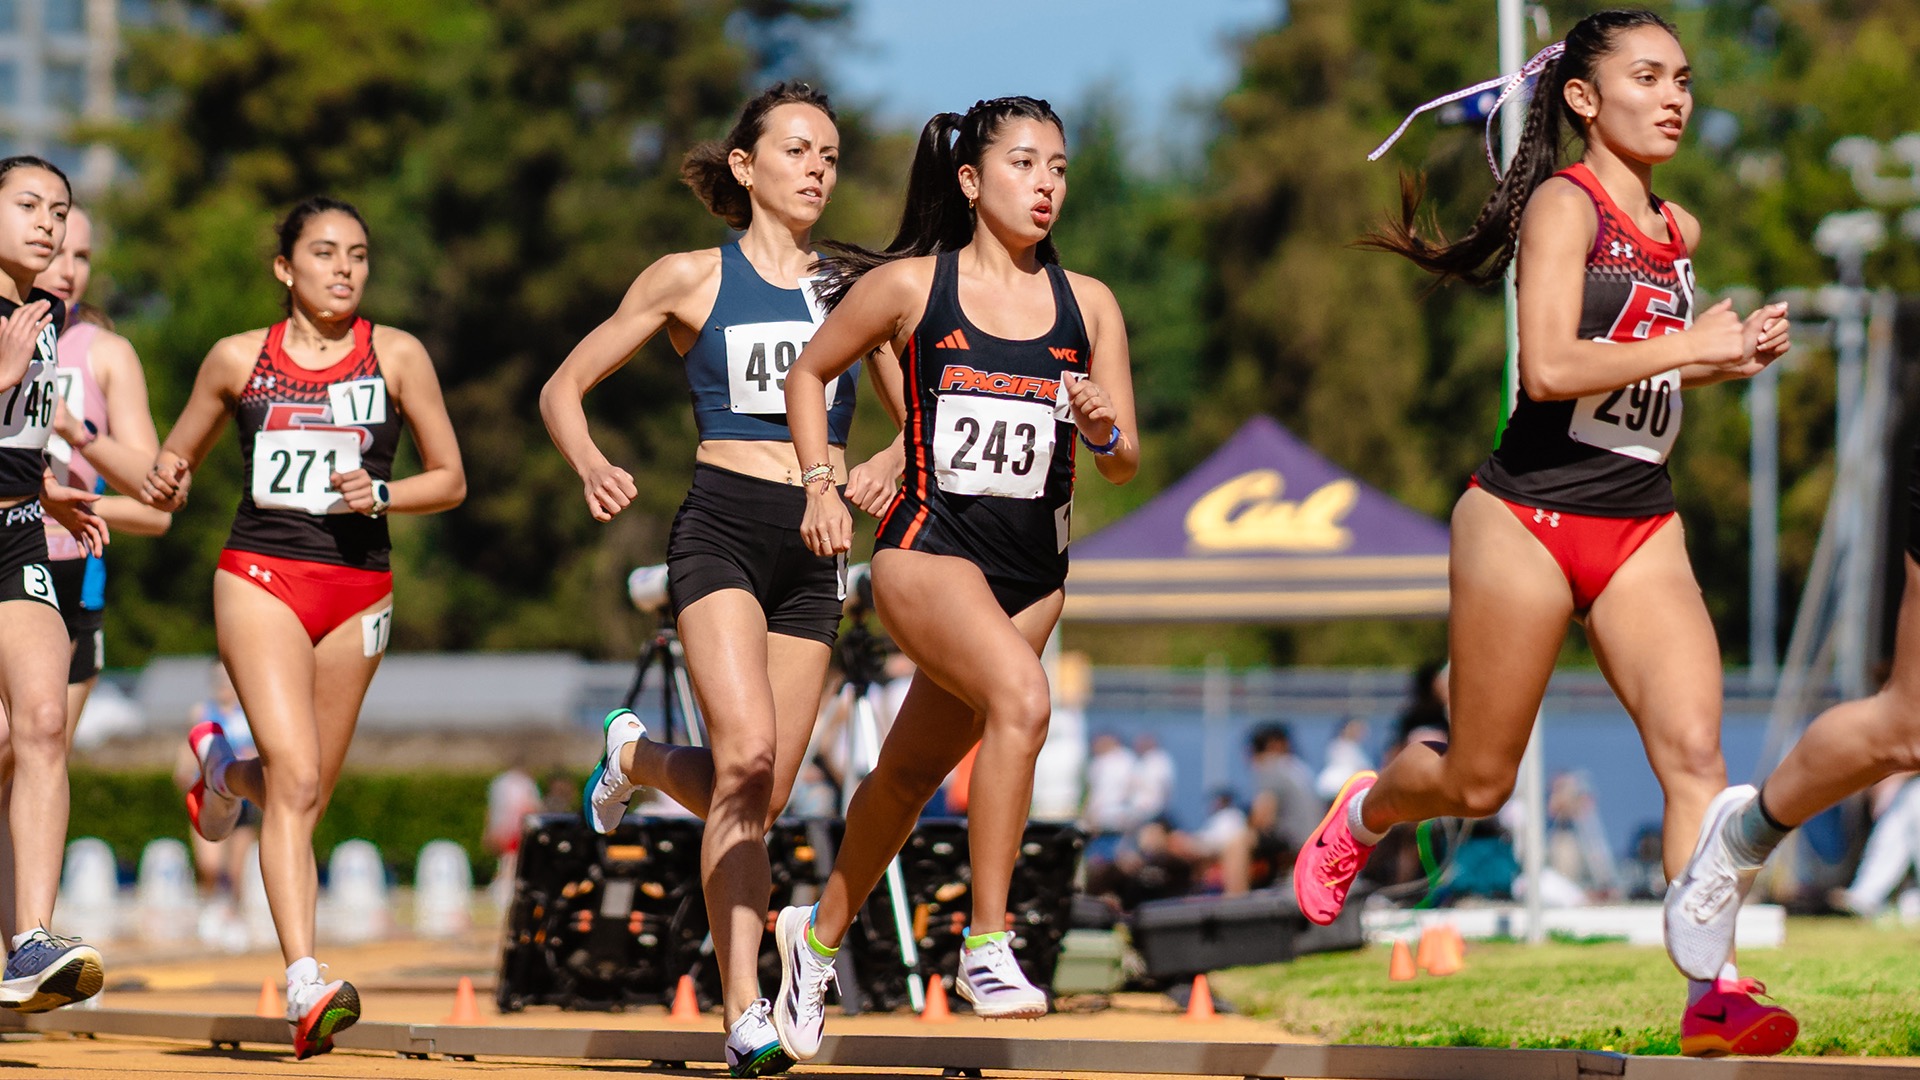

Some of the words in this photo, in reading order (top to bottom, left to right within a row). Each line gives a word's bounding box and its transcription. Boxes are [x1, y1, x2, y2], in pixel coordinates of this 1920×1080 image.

[745, 340, 810, 392] 49
[1048, 347, 1078, 363] WCC
[343, 384, 375, 421] 17
[1593, 379, 1671, 438] 290
[269, 449, 337, 494] 271
[950, 416, 1036, 476] 243
[1184, 468, 1360, 552] Cal
